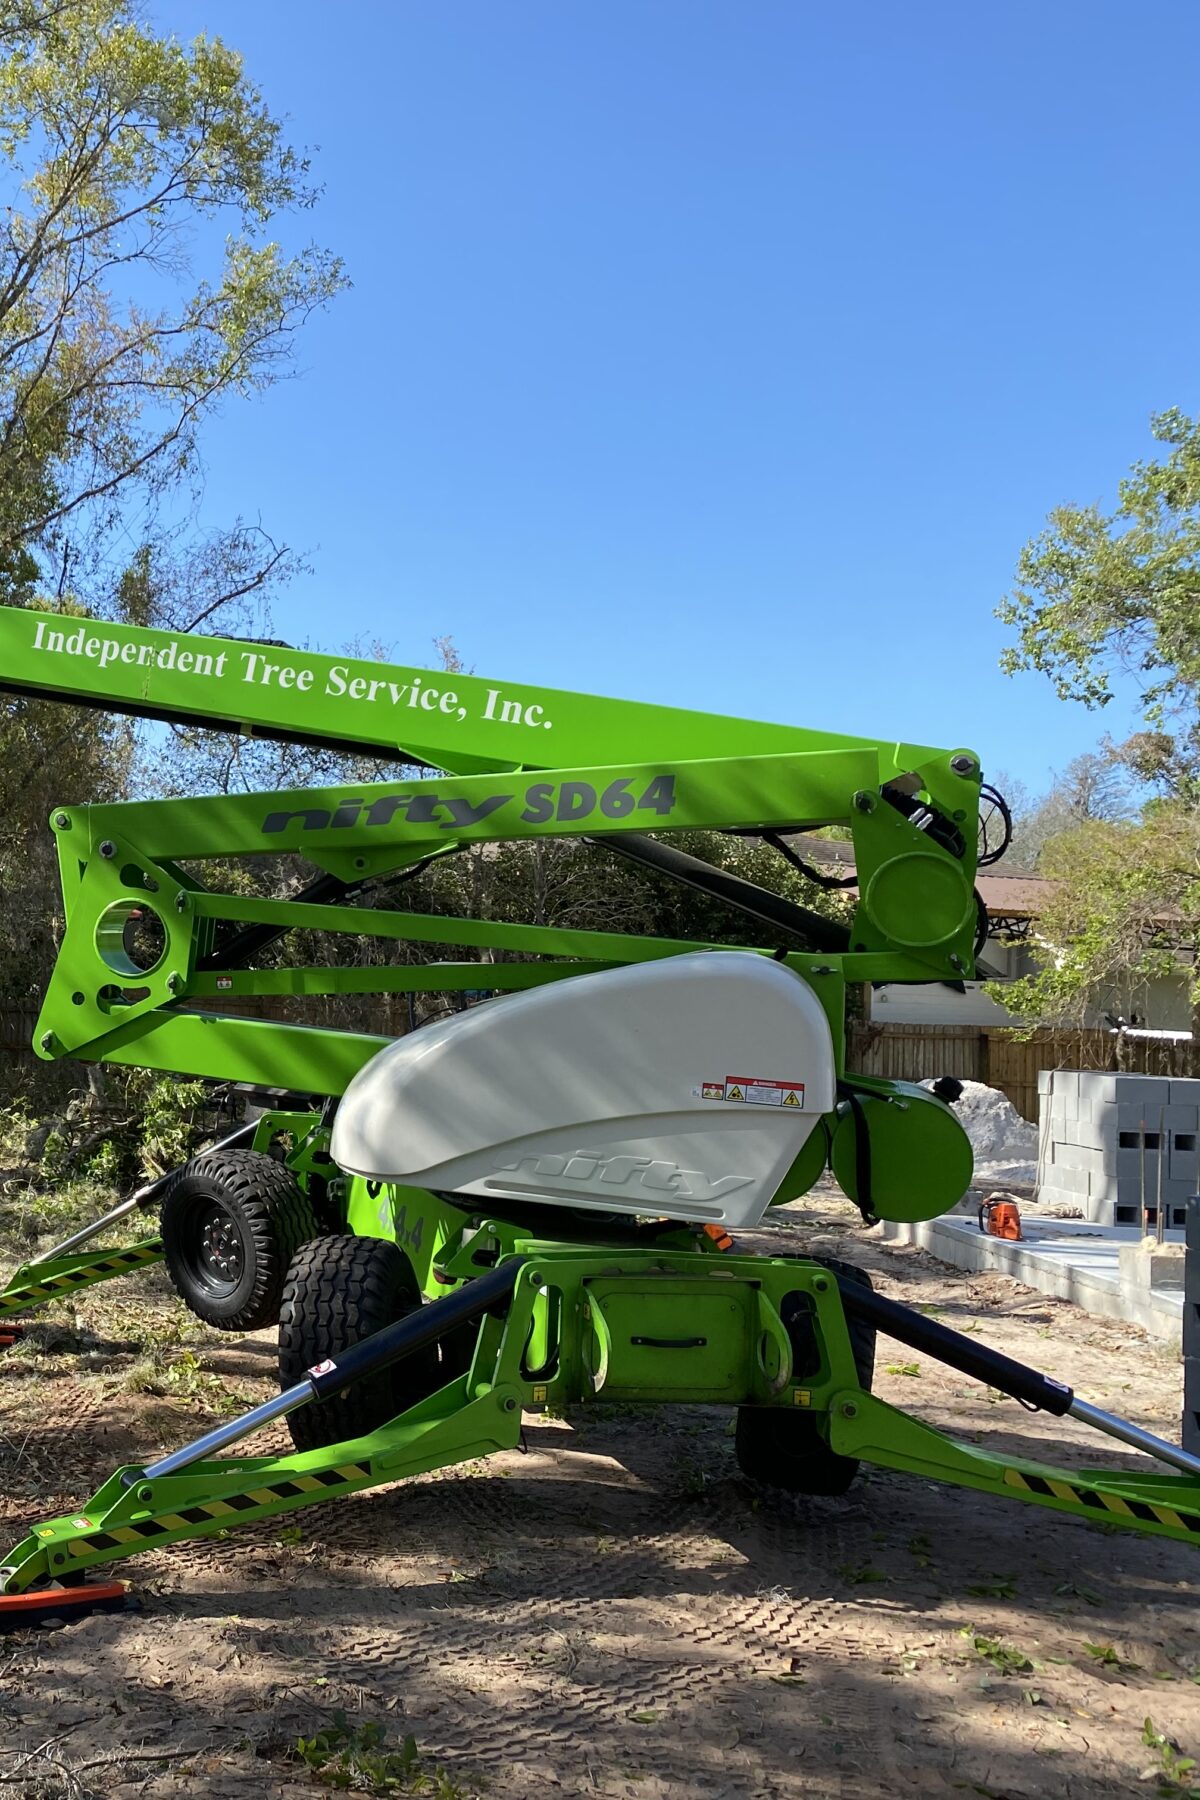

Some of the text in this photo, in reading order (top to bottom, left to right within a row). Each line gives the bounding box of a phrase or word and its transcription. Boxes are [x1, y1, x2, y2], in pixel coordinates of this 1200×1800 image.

[31, 621, 553, 729] Independent Tree Service, Inc.
[261, 775, 676, 834] nifty SD64
[492, 1150, 756, 1202] nifty
